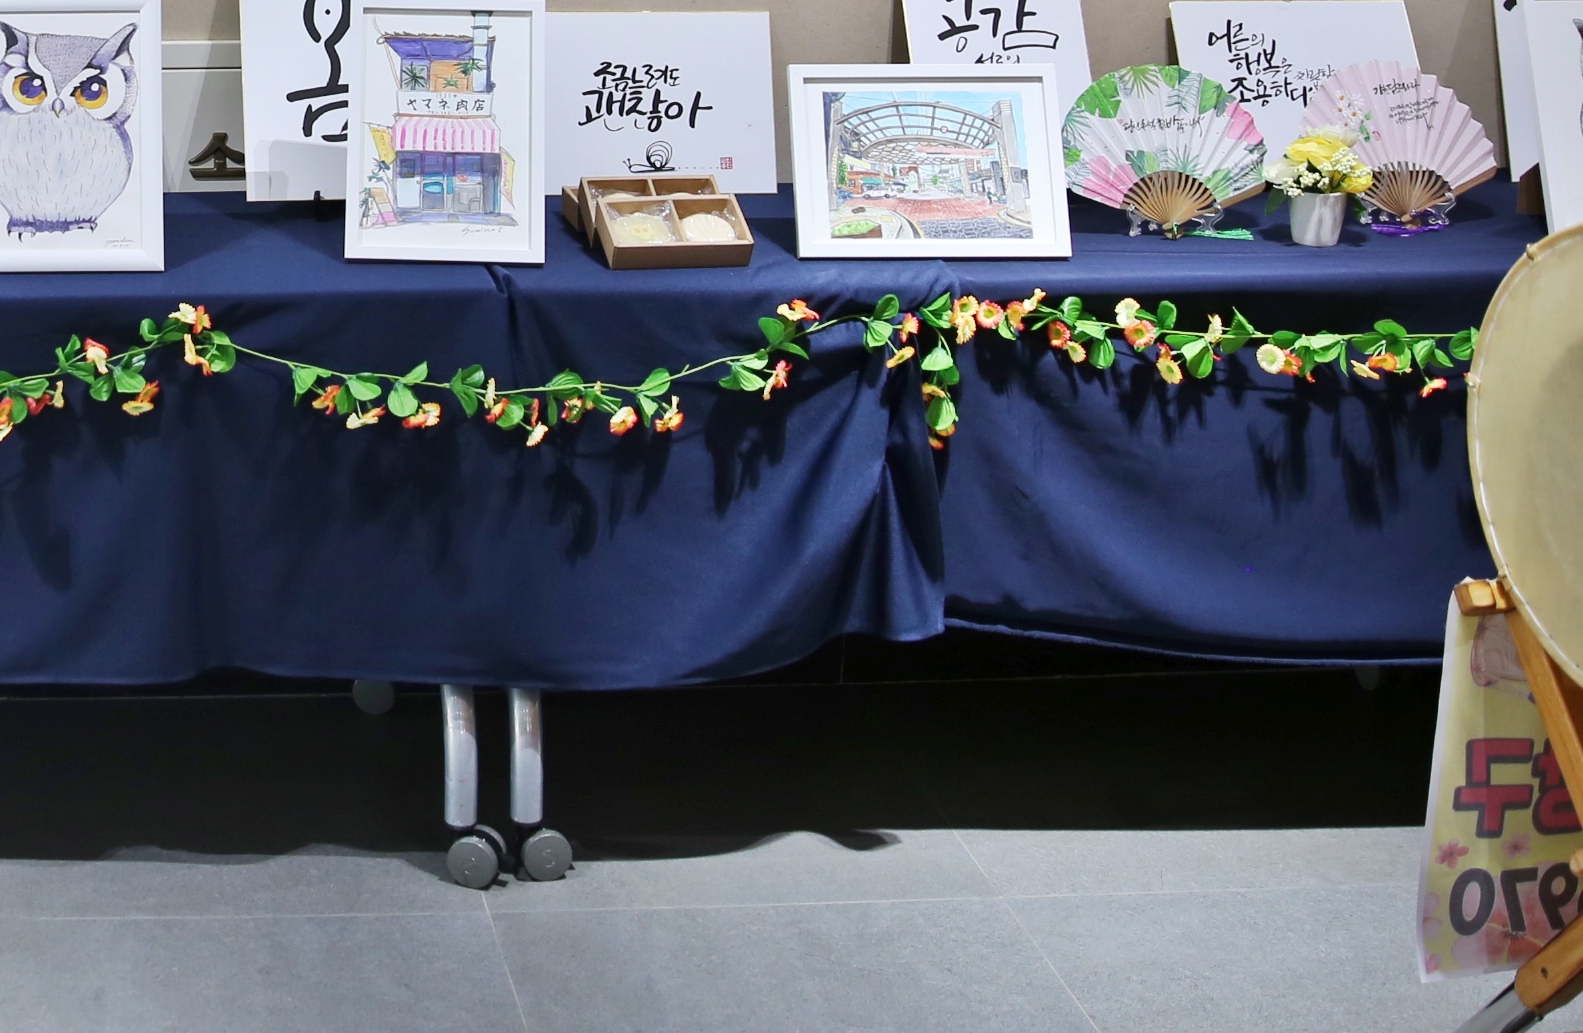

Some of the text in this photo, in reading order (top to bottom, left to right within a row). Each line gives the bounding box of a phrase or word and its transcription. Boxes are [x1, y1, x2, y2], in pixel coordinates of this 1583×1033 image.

[1207, 19, 1264, 53] 어른의
[1228, 39, 1292, 79] 행복은
[578, 88, 713, 133] 괜찮아
[1227, 77, 1313, 108] 조용하다
